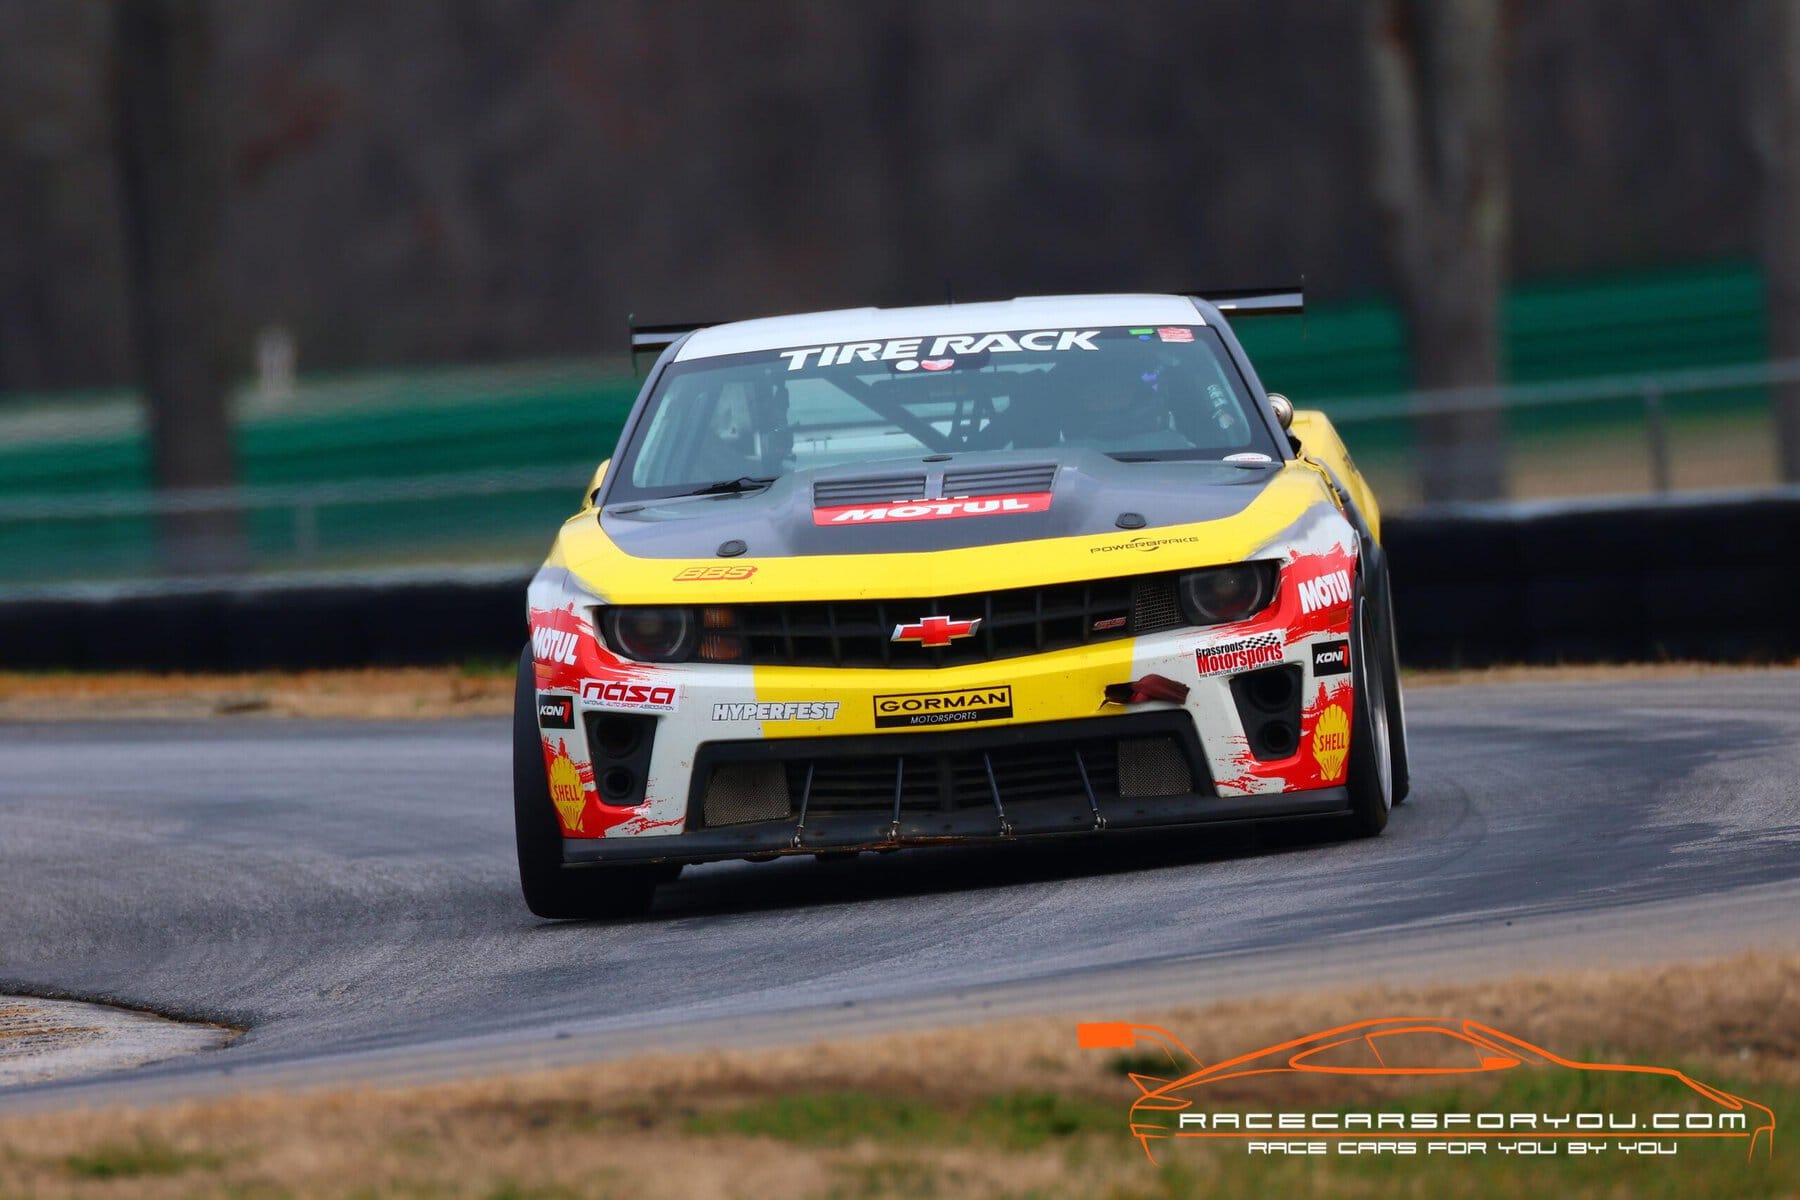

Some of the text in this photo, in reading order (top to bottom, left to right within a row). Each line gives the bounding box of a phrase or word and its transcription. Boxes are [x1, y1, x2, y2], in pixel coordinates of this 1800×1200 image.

[780, 330, 1101, 371] TIRE RACK
[832, 498, 1029, 521] MOTUL
[1090, 536, 1200, 554] POWERBRAKE
[672, 566, 758, 581] BBS
[533, 626, 579, 666] MOTUL
[1196, 641, 1244, 657] Grassroots
[1197, 643, 1283, 674] Motorsports
[1316, 651, 1343, 664] KONI
[540, 705, 565, 716] KONI
[880, 692, 1006, 712] GORMAN
[712, 702, 840, 721] HYPERFEST
[911, 711, 977, 724] MOTORSPORTS
[1319, 732, 1346, 752] SHELL
[554, 784, 580, 801] SHELL
